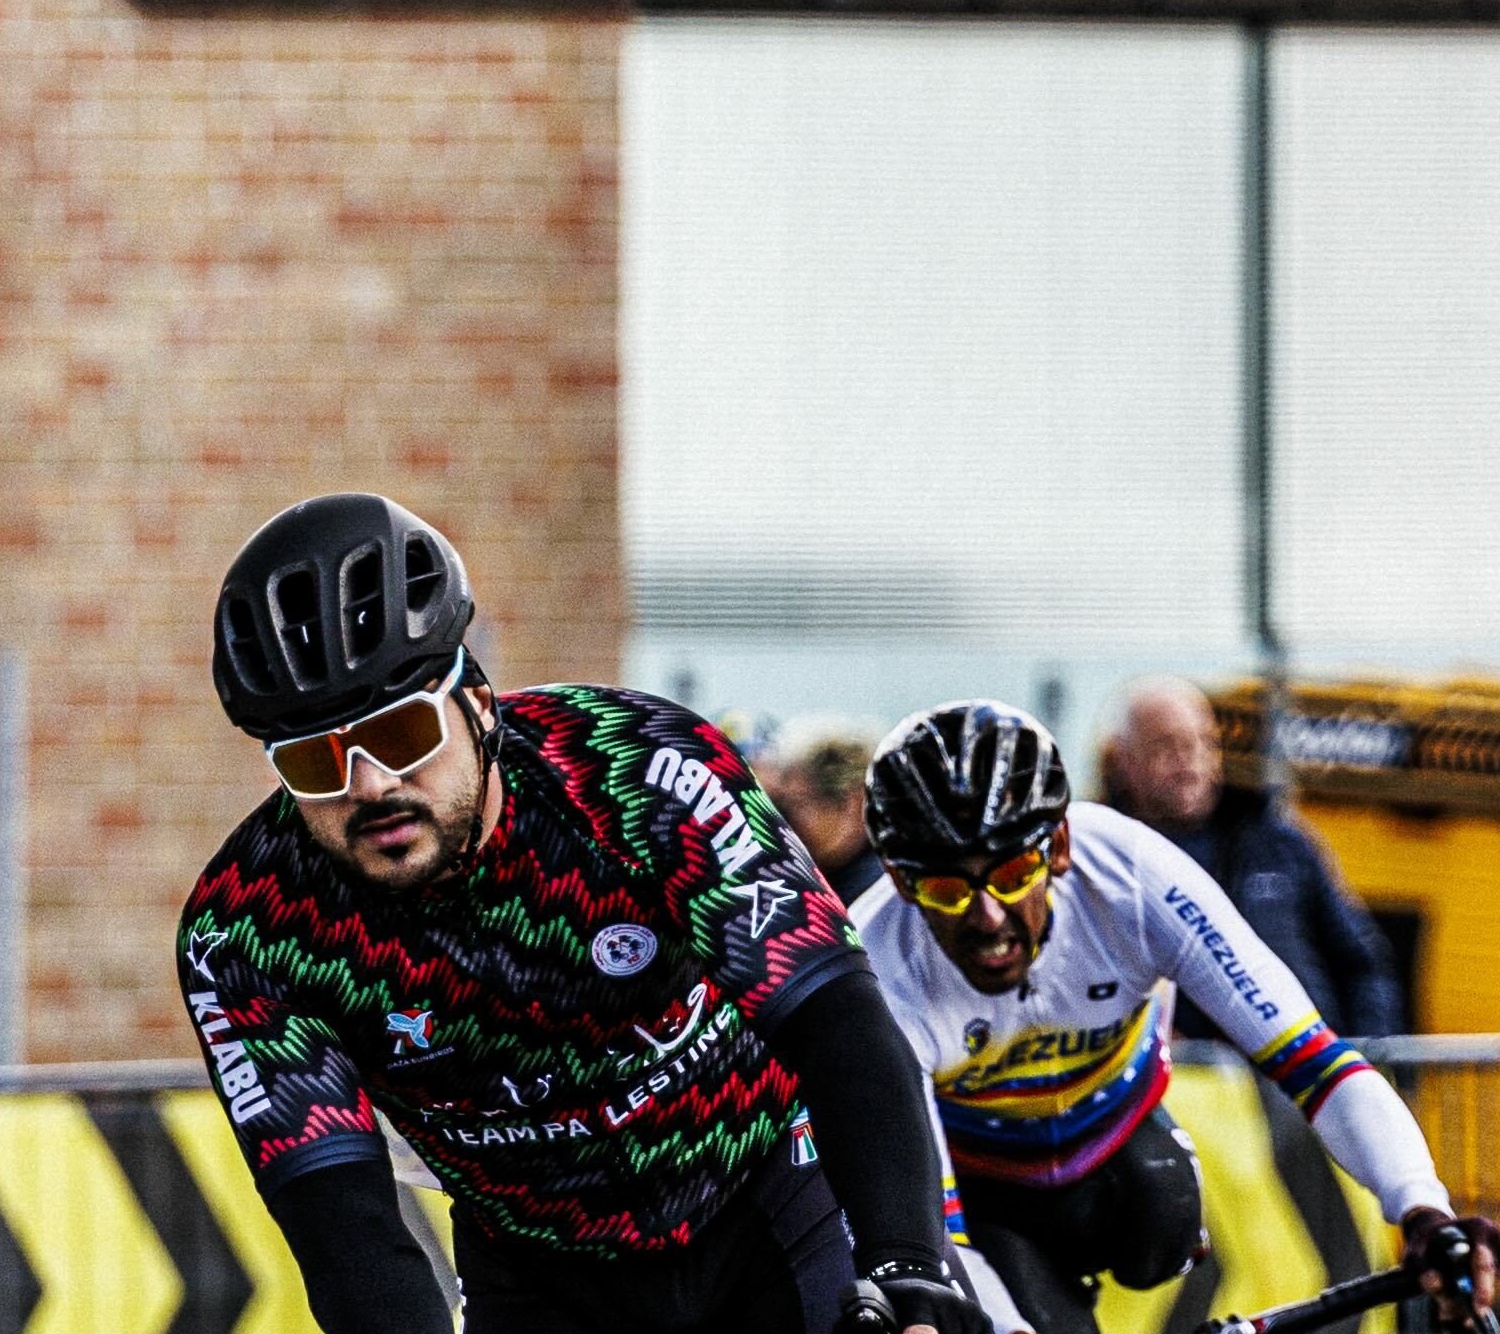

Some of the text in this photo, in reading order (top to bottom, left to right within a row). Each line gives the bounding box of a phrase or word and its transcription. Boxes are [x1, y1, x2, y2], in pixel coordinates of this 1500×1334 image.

[644, 747, 764, 875] KLABU
[1164, 886, 1279, 1020] VENEZUELA
[188, 991, 272, 1124] KLABU
